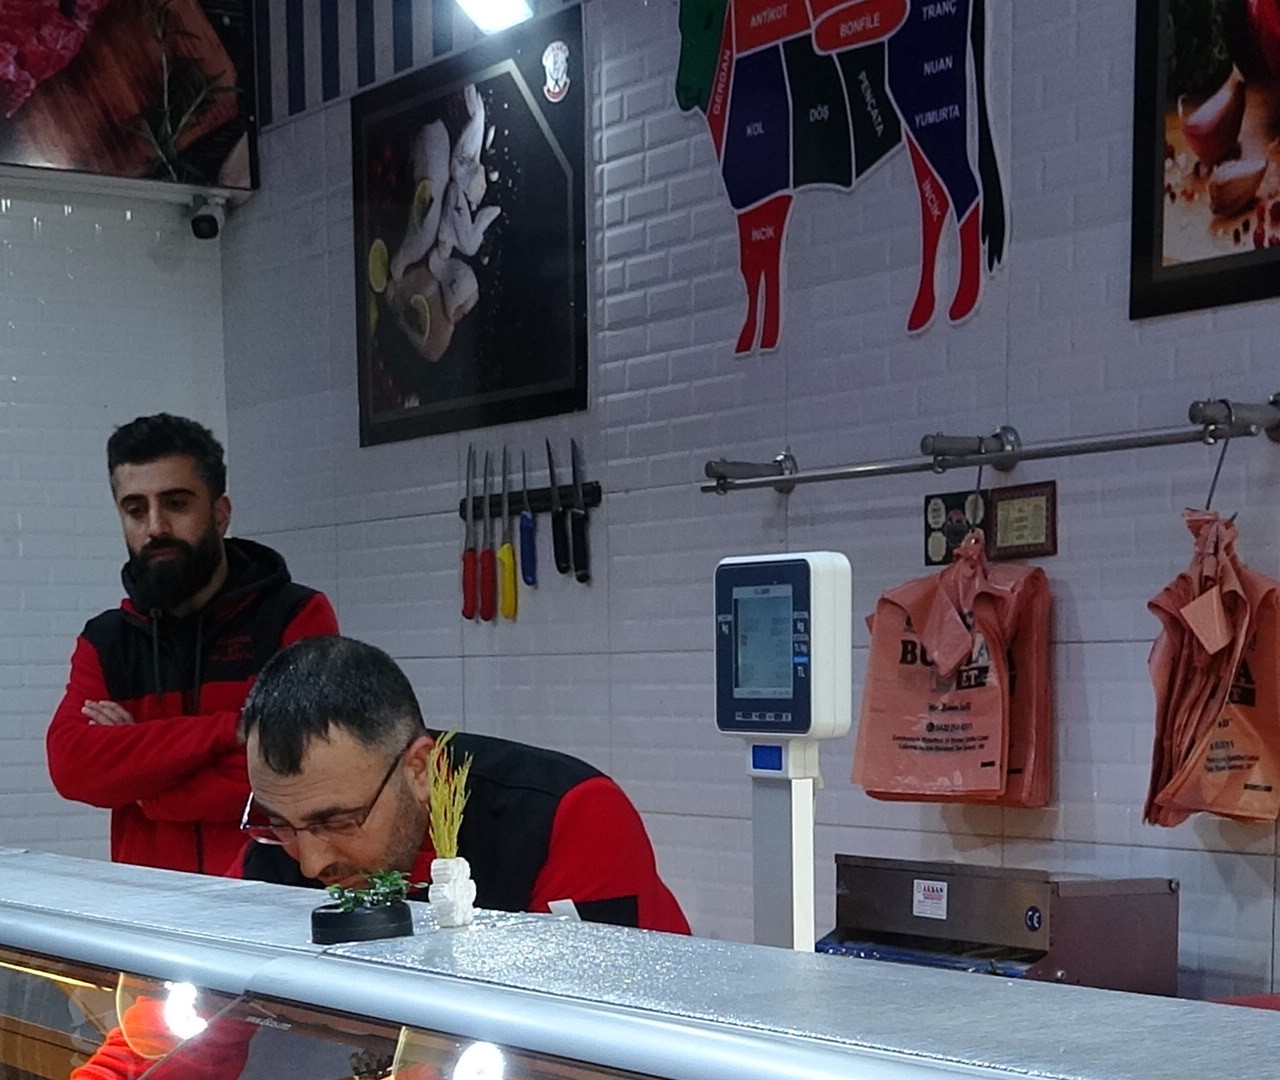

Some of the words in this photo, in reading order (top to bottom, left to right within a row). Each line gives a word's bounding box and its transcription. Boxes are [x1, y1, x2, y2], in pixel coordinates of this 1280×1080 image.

[923, 55, 954, 77] NUAN
[914, 103, 961, 129] YUMURTA
[746, 121, 765, 138] KOL
